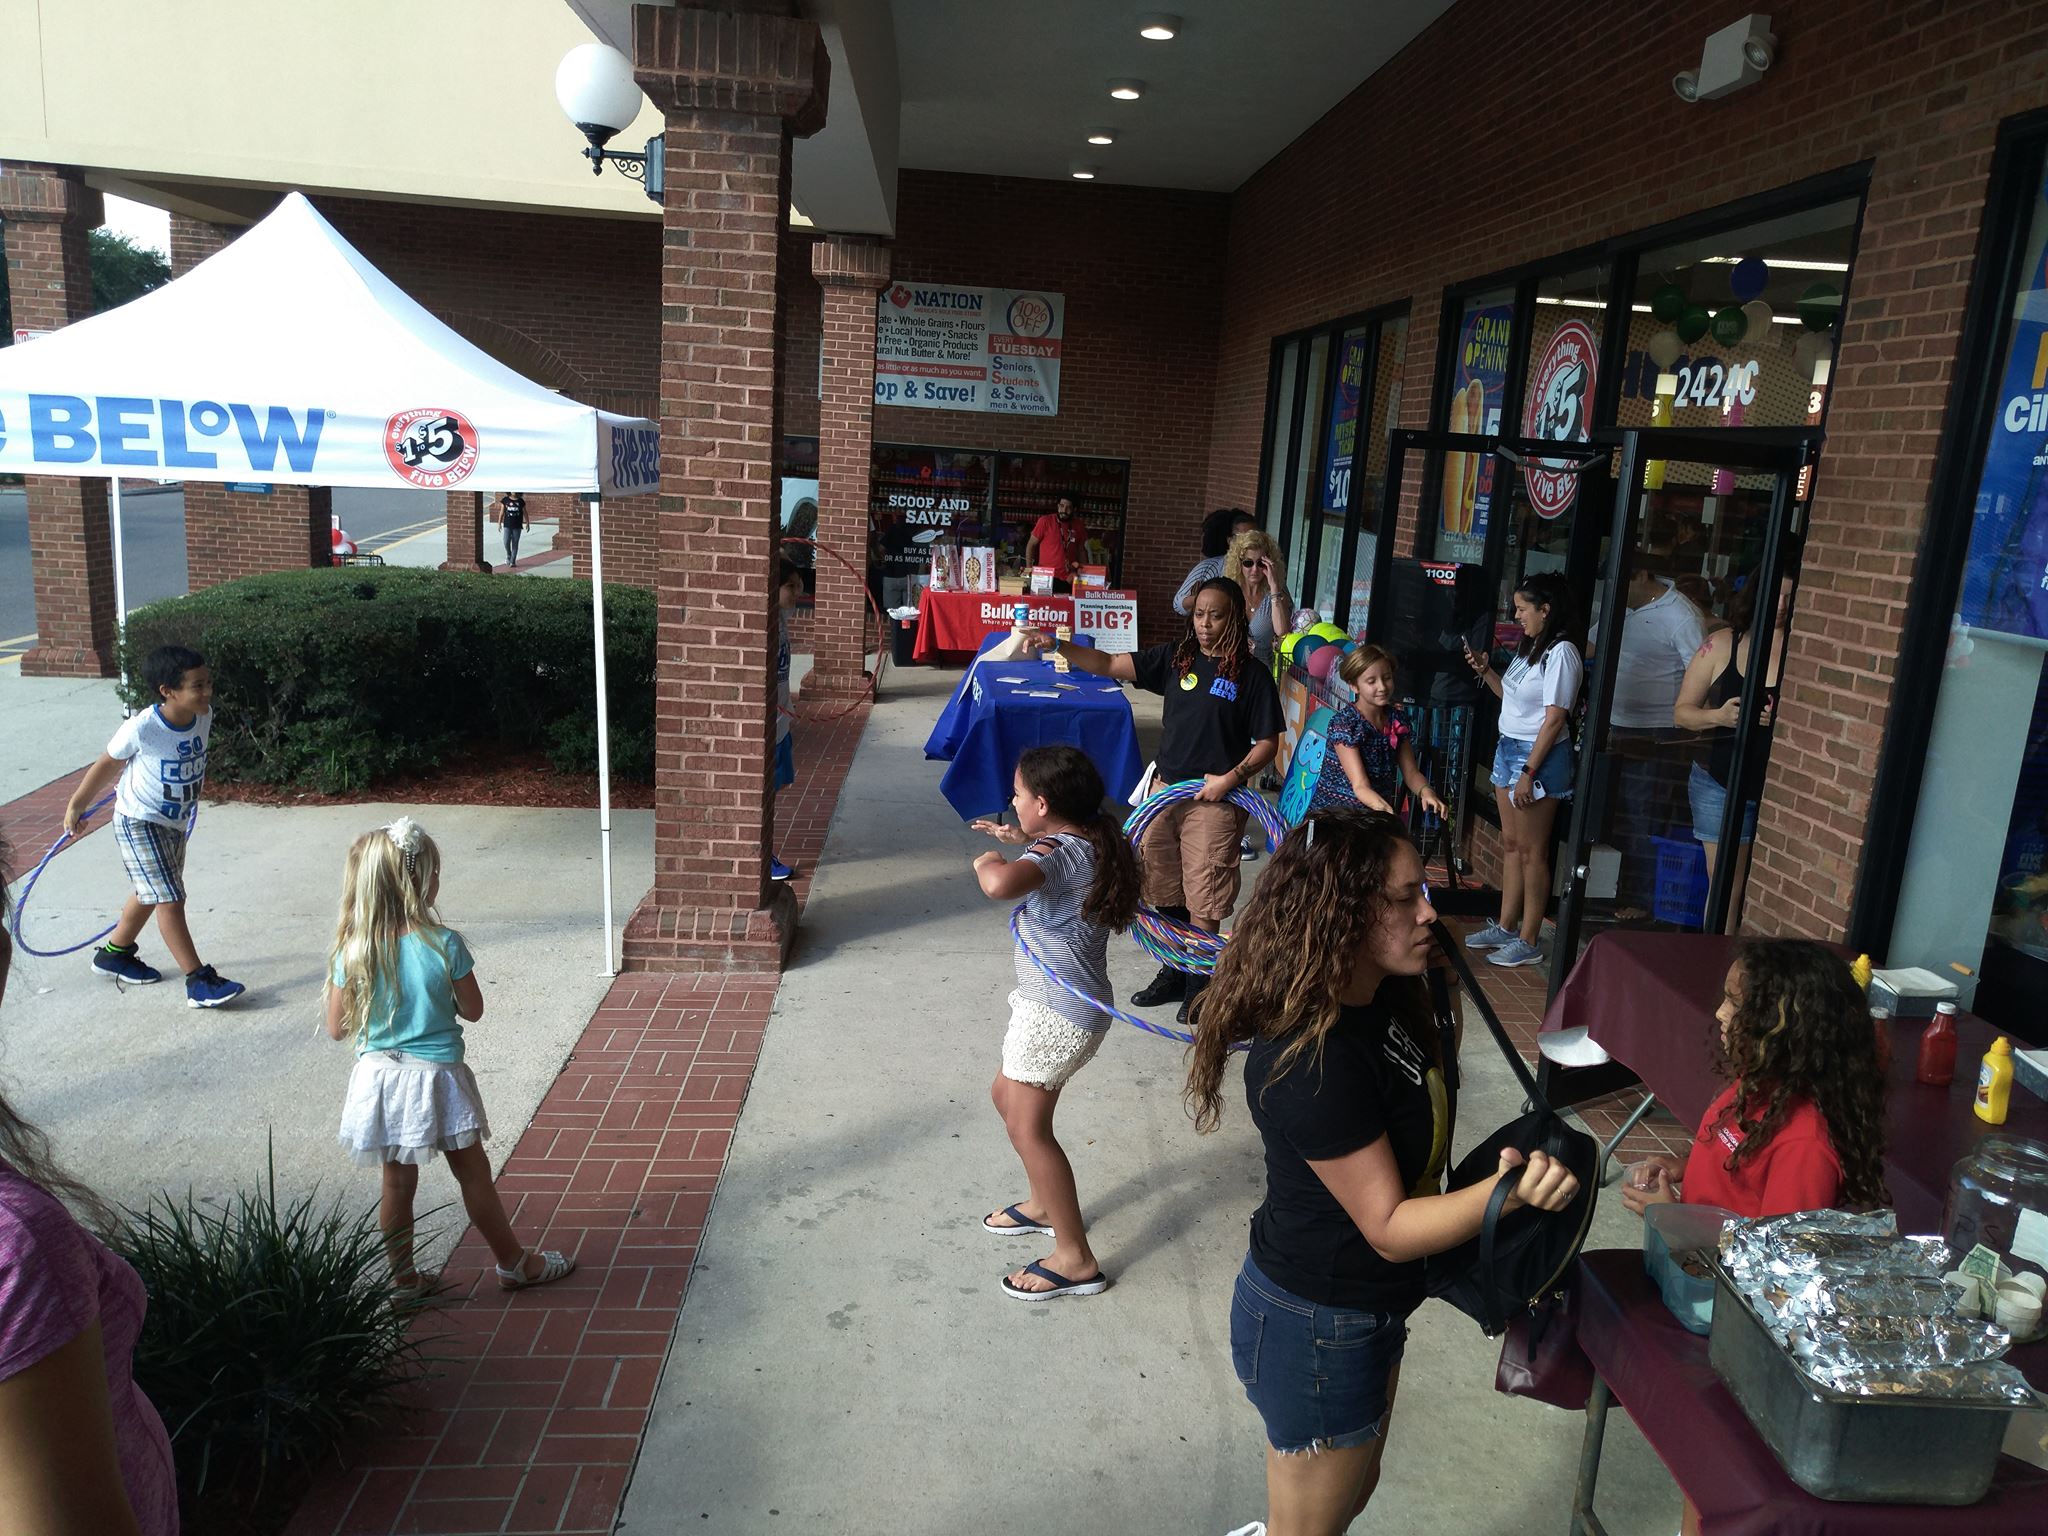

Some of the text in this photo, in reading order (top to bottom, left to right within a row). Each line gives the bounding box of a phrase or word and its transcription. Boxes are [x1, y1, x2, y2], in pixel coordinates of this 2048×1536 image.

[914, 290, 983, 310] NATION
[1018, 299, 1048, 322] 10%
[899, 316, 926, 326] Whole
[928, 319, 954, 329] Grains
[961, 320, 985, 331] Flours
[1013, 314, 1041, 333] OFF
[891, 326, 912, 335] Local
[915, 328, 941, 339] Honey
[948, 330, 978, 341] Snacks
[993, 335, 1014, 343] EVERY
[885, 336, 902, 345] Free
[909, 337, 940, 349] Organic
[943, 340, 979, 351] Products
[993, 343, 1054, 357] TUESDAY
[895, 347, 909, 356] Nut
[912, 348, 935, 358] Butter
[937, 350, 945, 359] &
[947, 350, 971, 361] More!
[919, 366, 939, 374] much
[949, 368, 962, 377] you
[992, 356, 1036, 374] Seniors,
[1537, 339, 1580, 403] everything
[992, 371, 1040, 387] Students
[1674, 360, 1759, 407] 2424C
[904, 380, 918, 399] &
[924, 381, 976, 403] Save!
[990, 386, 1045, 403] & Service
[990, 402, 1050, 412] men & women
[1808, 391, 1822, 414] 3
[391, 409, 442, 439] everything
[888, 495, 969, 511] SCOOP AND
[905, 510, 952, 526] SAVE
[904, 556, 924, 564] MUCH
[1080, 610, 1133, 630] BIG?
